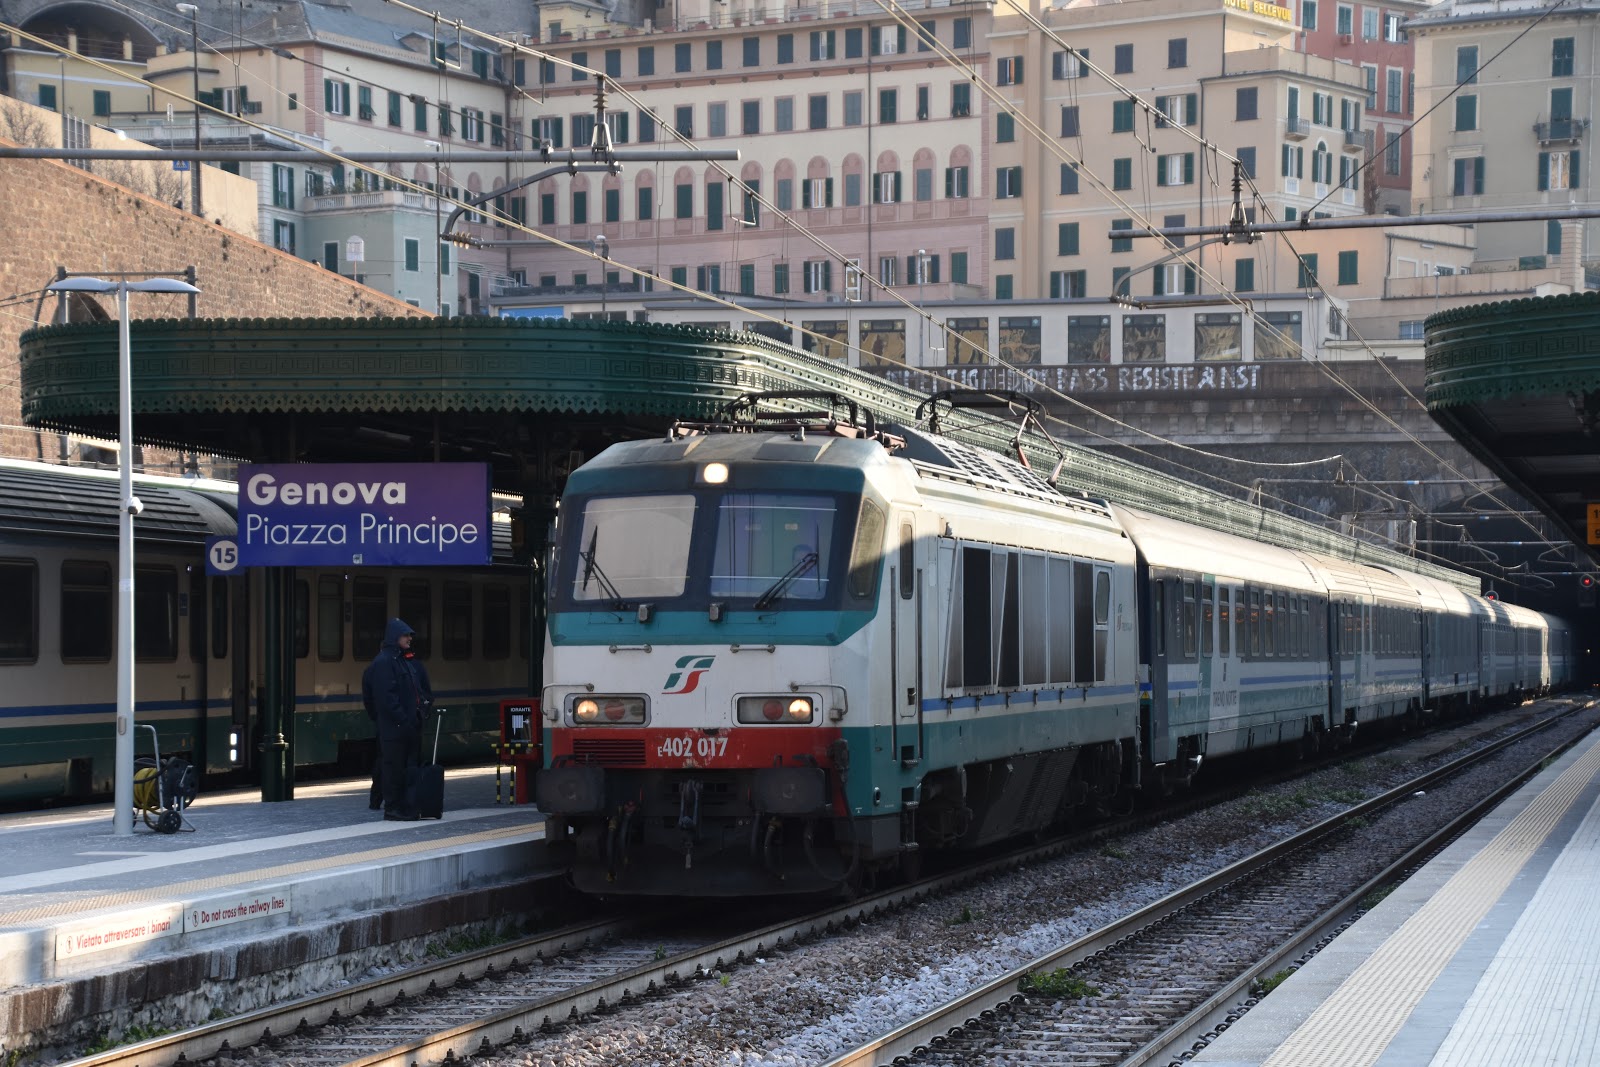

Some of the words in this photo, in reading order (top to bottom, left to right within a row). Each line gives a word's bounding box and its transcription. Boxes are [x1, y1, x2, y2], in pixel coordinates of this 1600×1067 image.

[1253, 1, 1293, 21] BELLEVUE
[247, 473, 406, 506] Genova
[247, 514, 346, 545] Piazza
[360, 513, 478, 552] Principe
[214, 548, 236, 564] 15
[698, 737, 728, 757] 017
[201, 910, 210, 924] Do
[211, 907, 221, 922] not
[222, 905, 237, 920] cross
[237, 902, 247, 916] the
[248, 898, 270, 915] railway
[271, 896, 285, 910] lines
[76, 934, 102, 950] Vietato
[104, 926, 145, 945] attraversare
[151, 916, 171, 934] binari
